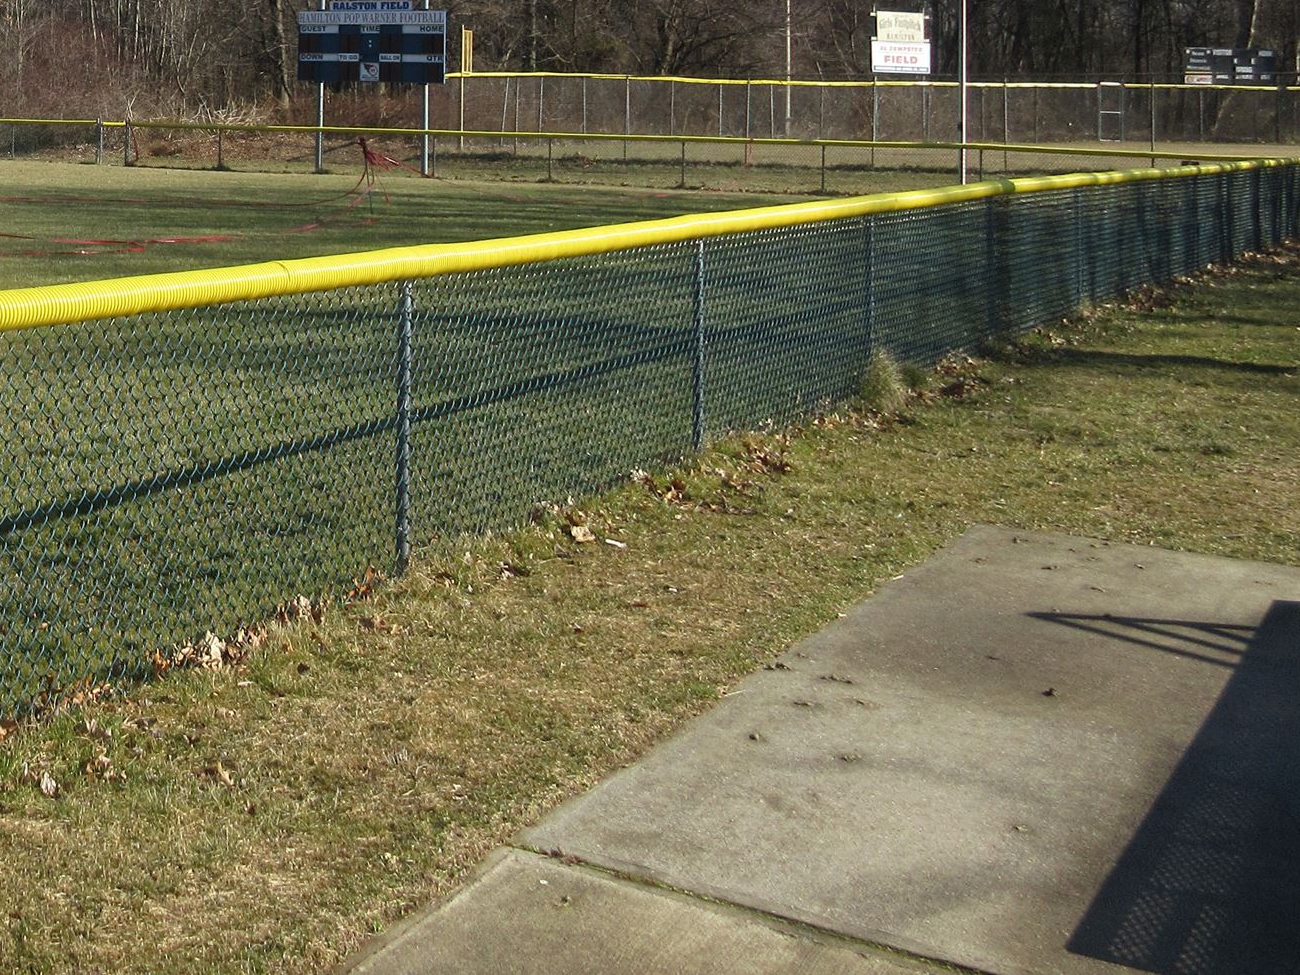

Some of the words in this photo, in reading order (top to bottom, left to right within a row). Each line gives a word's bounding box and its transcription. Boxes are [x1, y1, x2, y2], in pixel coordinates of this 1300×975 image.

[333, 2, 377, 10] RALSTON
[381, 1, 409, 10] FIELD
[300, 12, 340, 24] HAMILTON
[344, 12, 361, 24] POP
[361, 12, 397, 24] WARNER
[400, 12, 444, 24] FOOTBALL
[884, 55, 918, 64] FIELD
